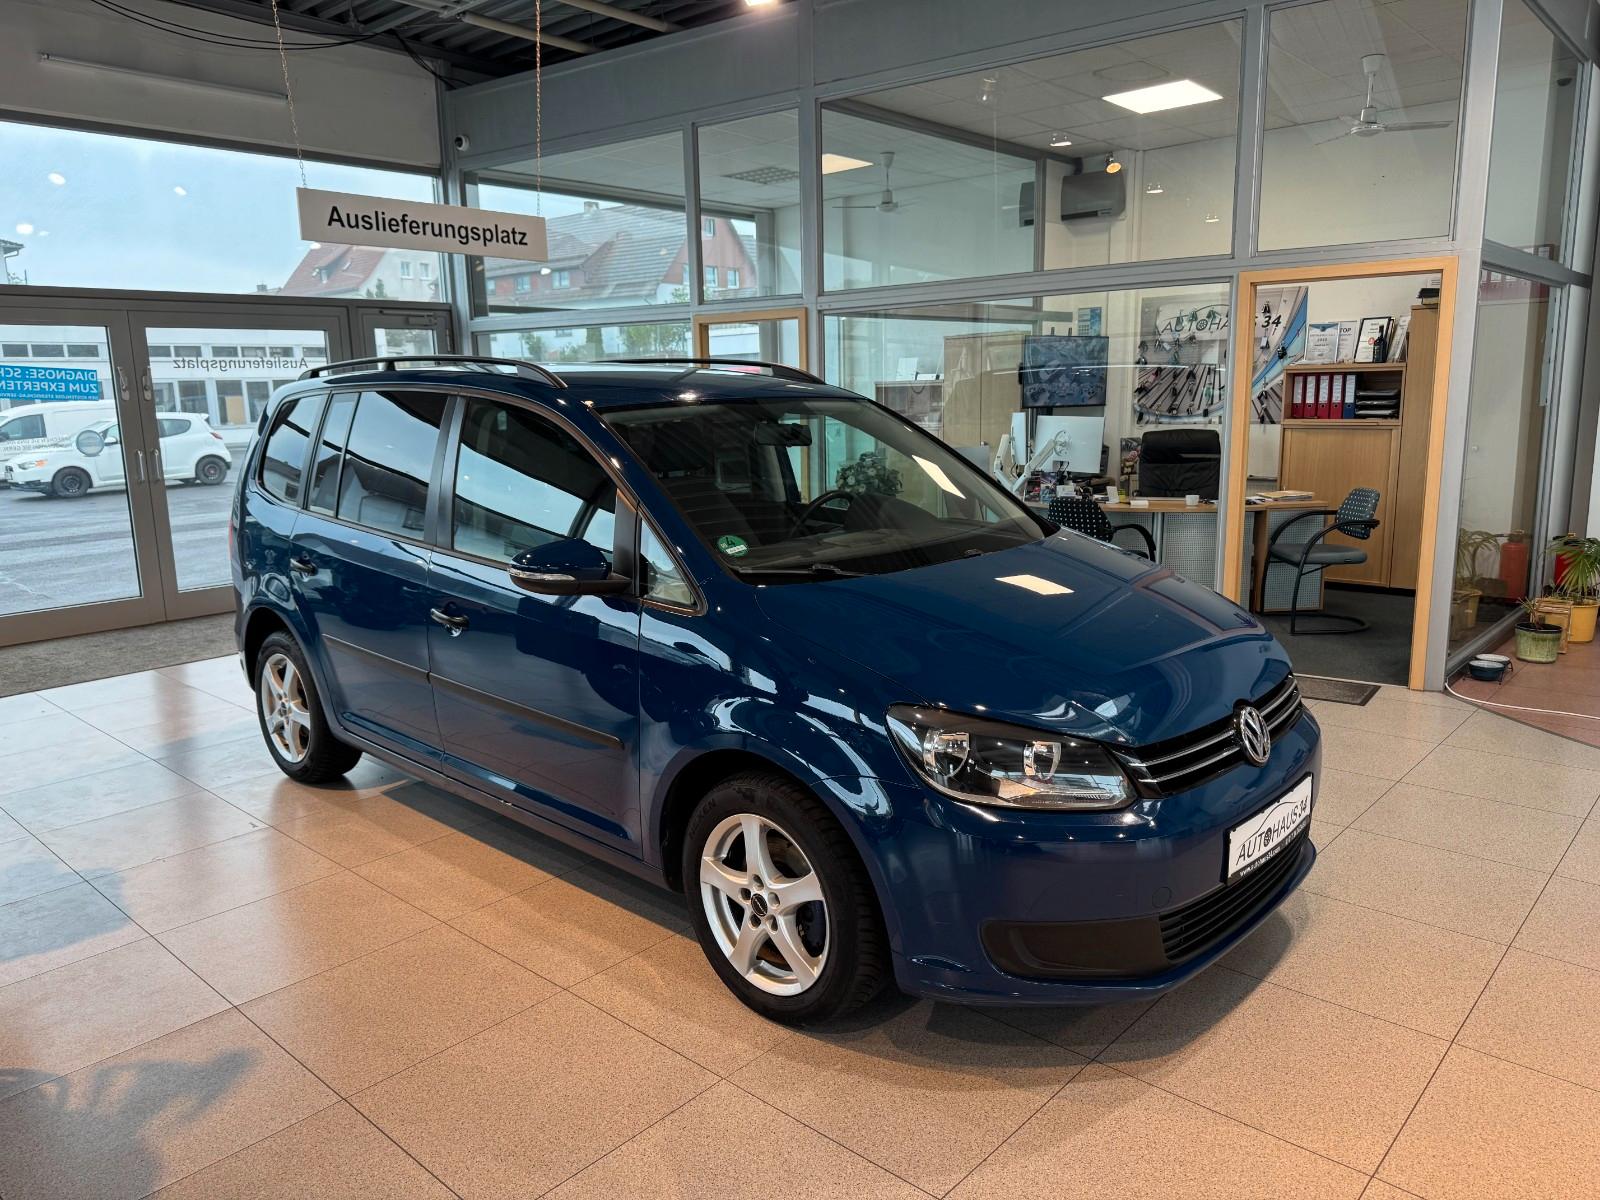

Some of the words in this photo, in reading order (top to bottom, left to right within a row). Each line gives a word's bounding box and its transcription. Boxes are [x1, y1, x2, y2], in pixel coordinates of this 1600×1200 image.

[327, 205, 529, 247] Auslieferungsplatz
[1161, 316, 1258, 334] AUTOHA
[1261, 314, 1282, 328] 34
[1236, 804, 1299, 866] AUTOHAUS
[1299, 796, 1309, 819] 34
